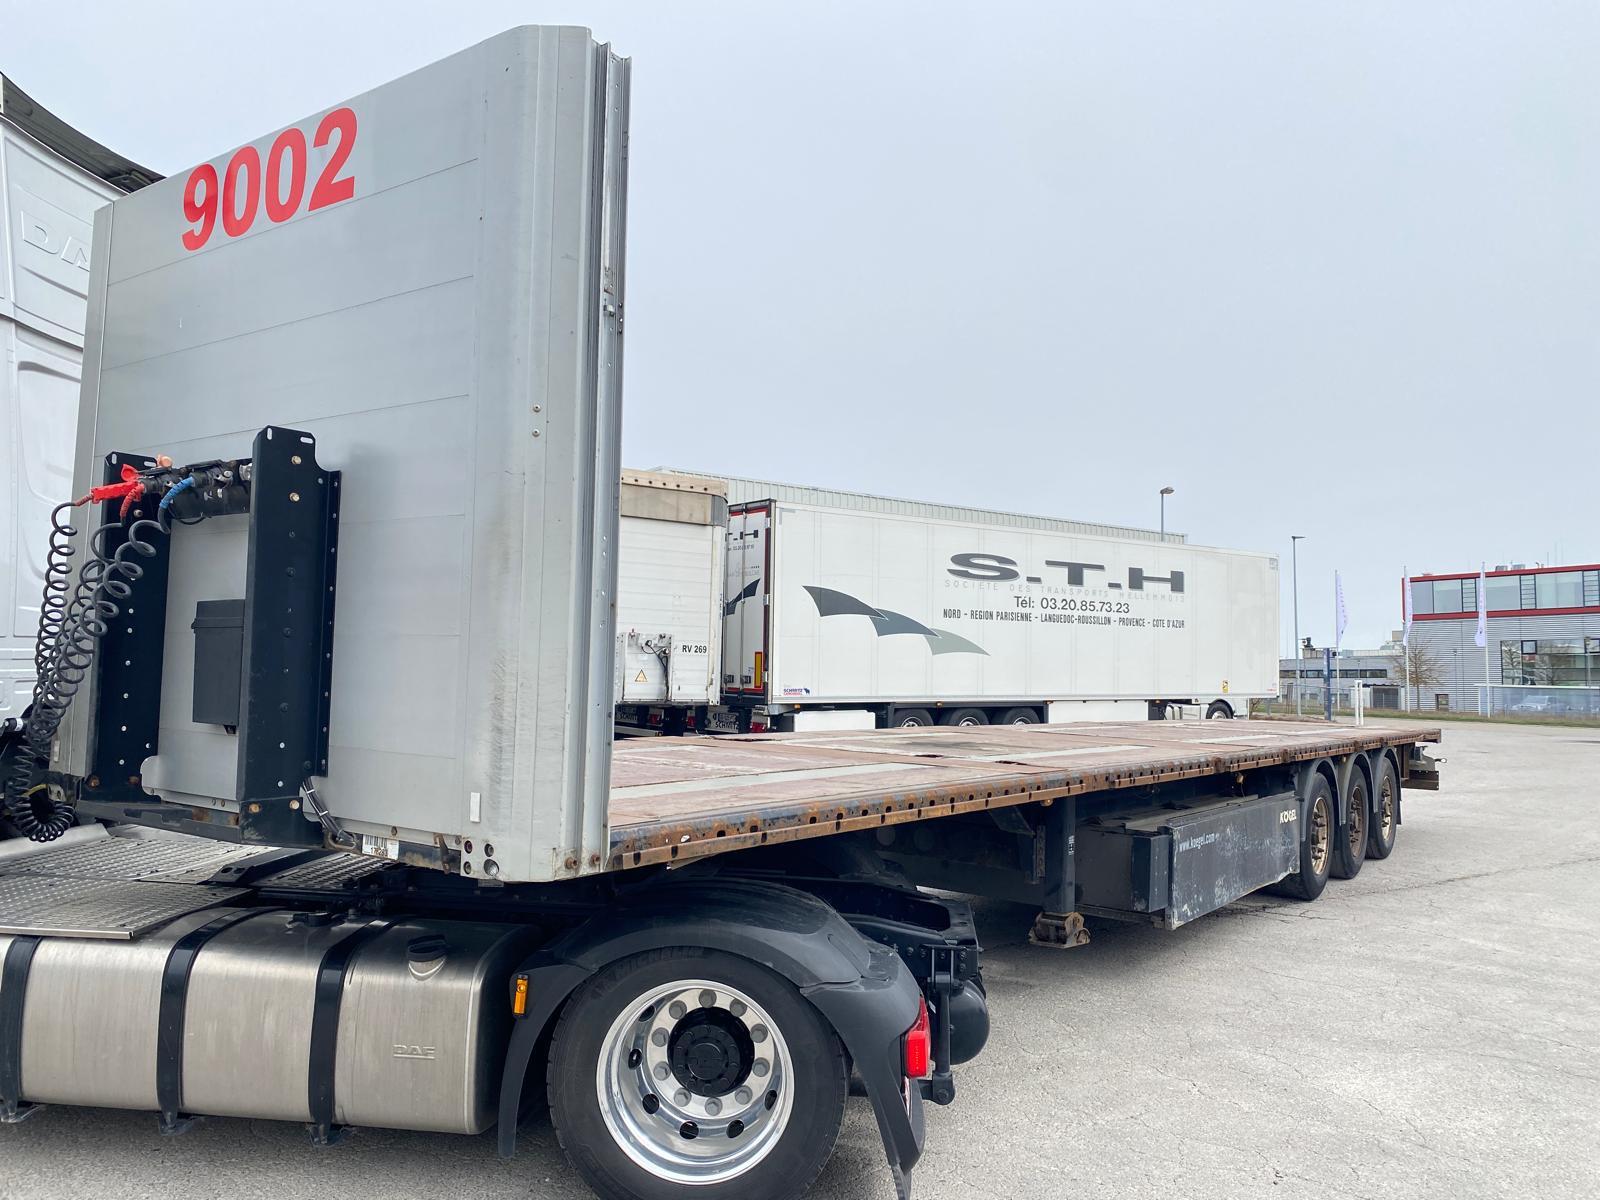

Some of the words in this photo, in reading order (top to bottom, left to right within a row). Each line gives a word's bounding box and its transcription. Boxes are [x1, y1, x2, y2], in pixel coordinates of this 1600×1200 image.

[182, 107, 357, 251] 9002
[20, 209, 91, 273] DA
[1013, 595, 1036, 609] Tél:
[1040, 597, 1130, 614] 03.20.85.73.23
[943, 608, 961, 619] NORD
[970, 609, 994, 621] REGION
[996, 612, 1033, 623] PARISIENNE
[1040, 613, 1112, 626] LANGUEDOC-ROUSSILLON
[1118, 617, 1146, 628] PROVENCE
[682, 644, 693, 653] RV
[694, 644, 708, 654] 269
